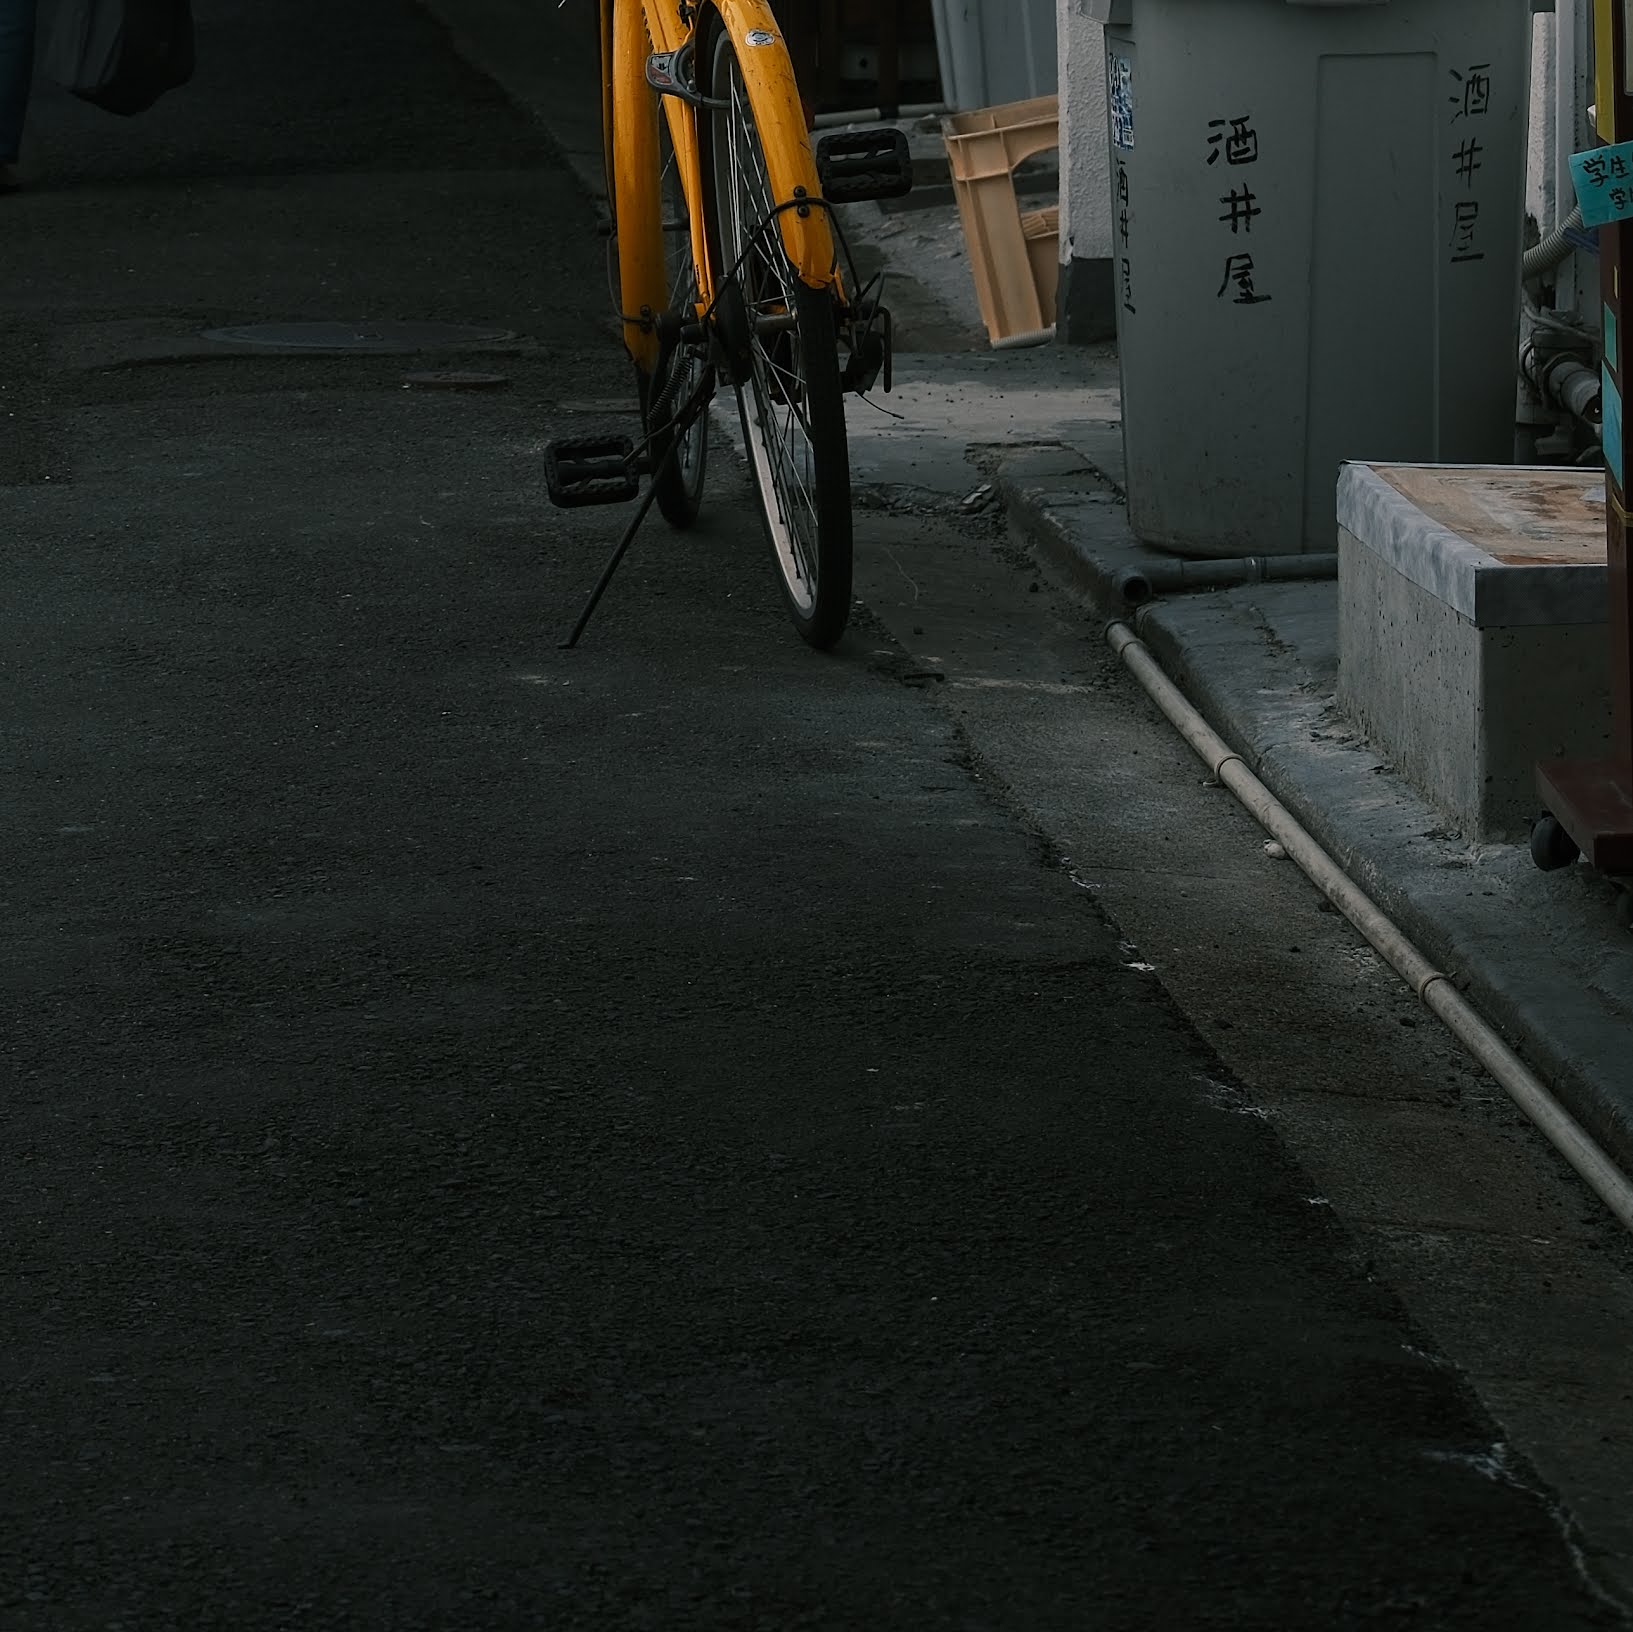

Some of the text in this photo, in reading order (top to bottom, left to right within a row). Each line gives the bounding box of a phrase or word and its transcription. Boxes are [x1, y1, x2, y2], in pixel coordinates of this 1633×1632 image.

[1206, 116, 1271, 306] 酒井屋
[1583, 152, 1633, 187] 学生
